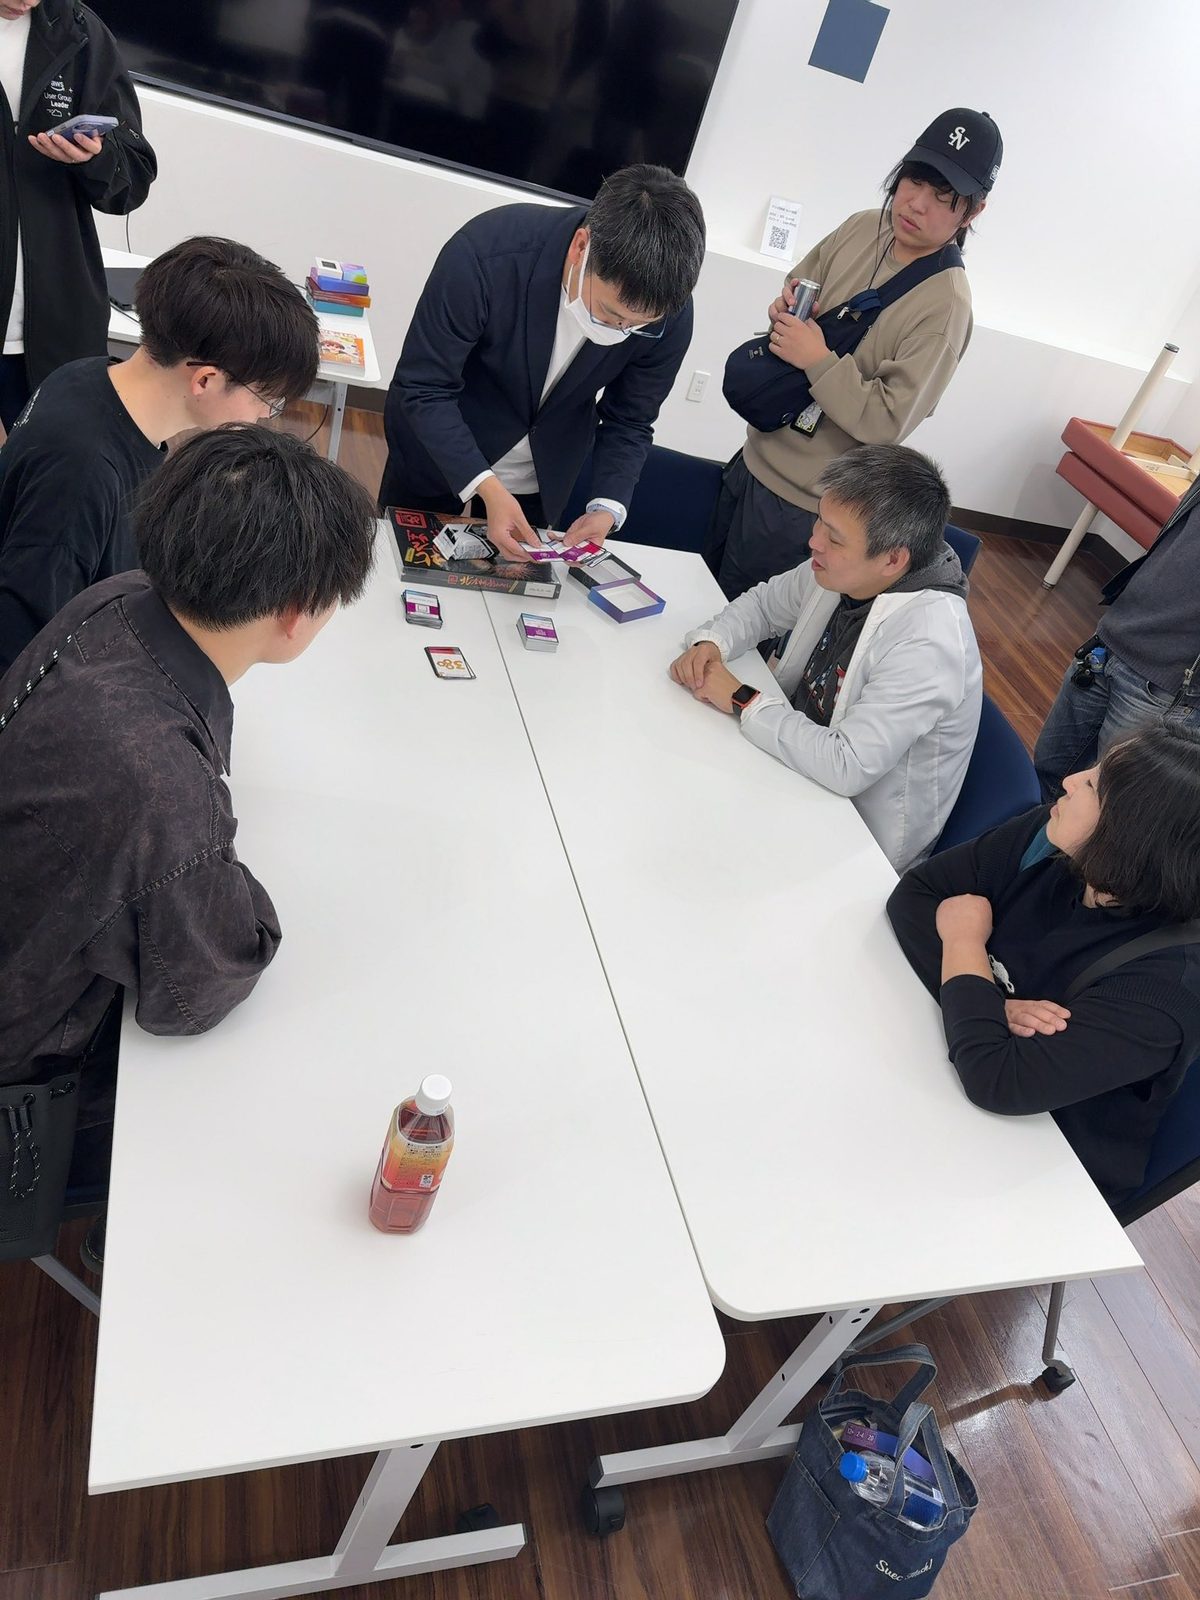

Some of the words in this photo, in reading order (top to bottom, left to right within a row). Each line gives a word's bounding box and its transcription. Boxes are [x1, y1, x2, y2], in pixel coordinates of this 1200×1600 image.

[44, 92, 57, 100] User
[57, 93, 72, 102] Group
[51, 100, 70, 109] Leader
